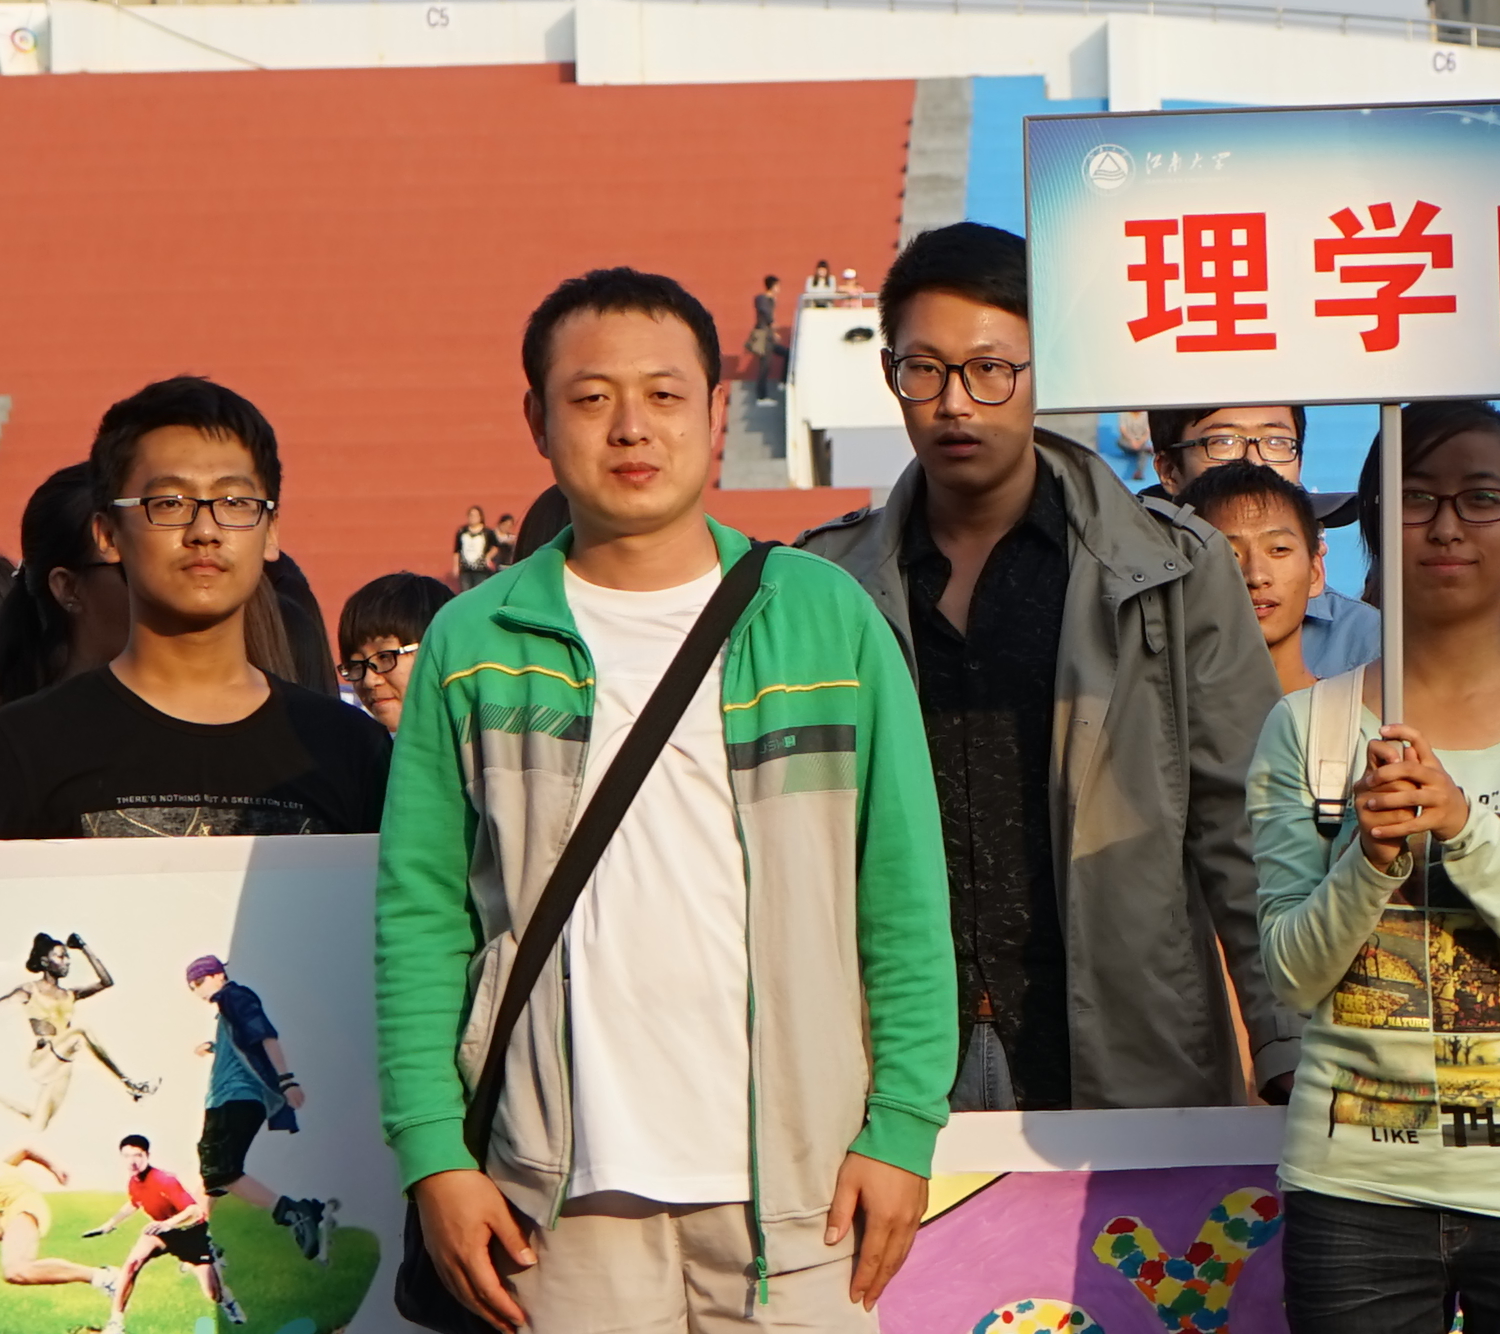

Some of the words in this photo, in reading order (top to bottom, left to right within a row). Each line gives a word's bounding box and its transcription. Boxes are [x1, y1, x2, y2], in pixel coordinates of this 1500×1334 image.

[427, 7, 450, 28] C5
[1433, 51, 1456, 72] C6
[159, 793, 201, 803] NOTHING
[231, 795, 281, 807] SKELETON
[1387, 1015, 1431, 1028] NATURE
[1370, 1126, 1420, 1145] LIKE
